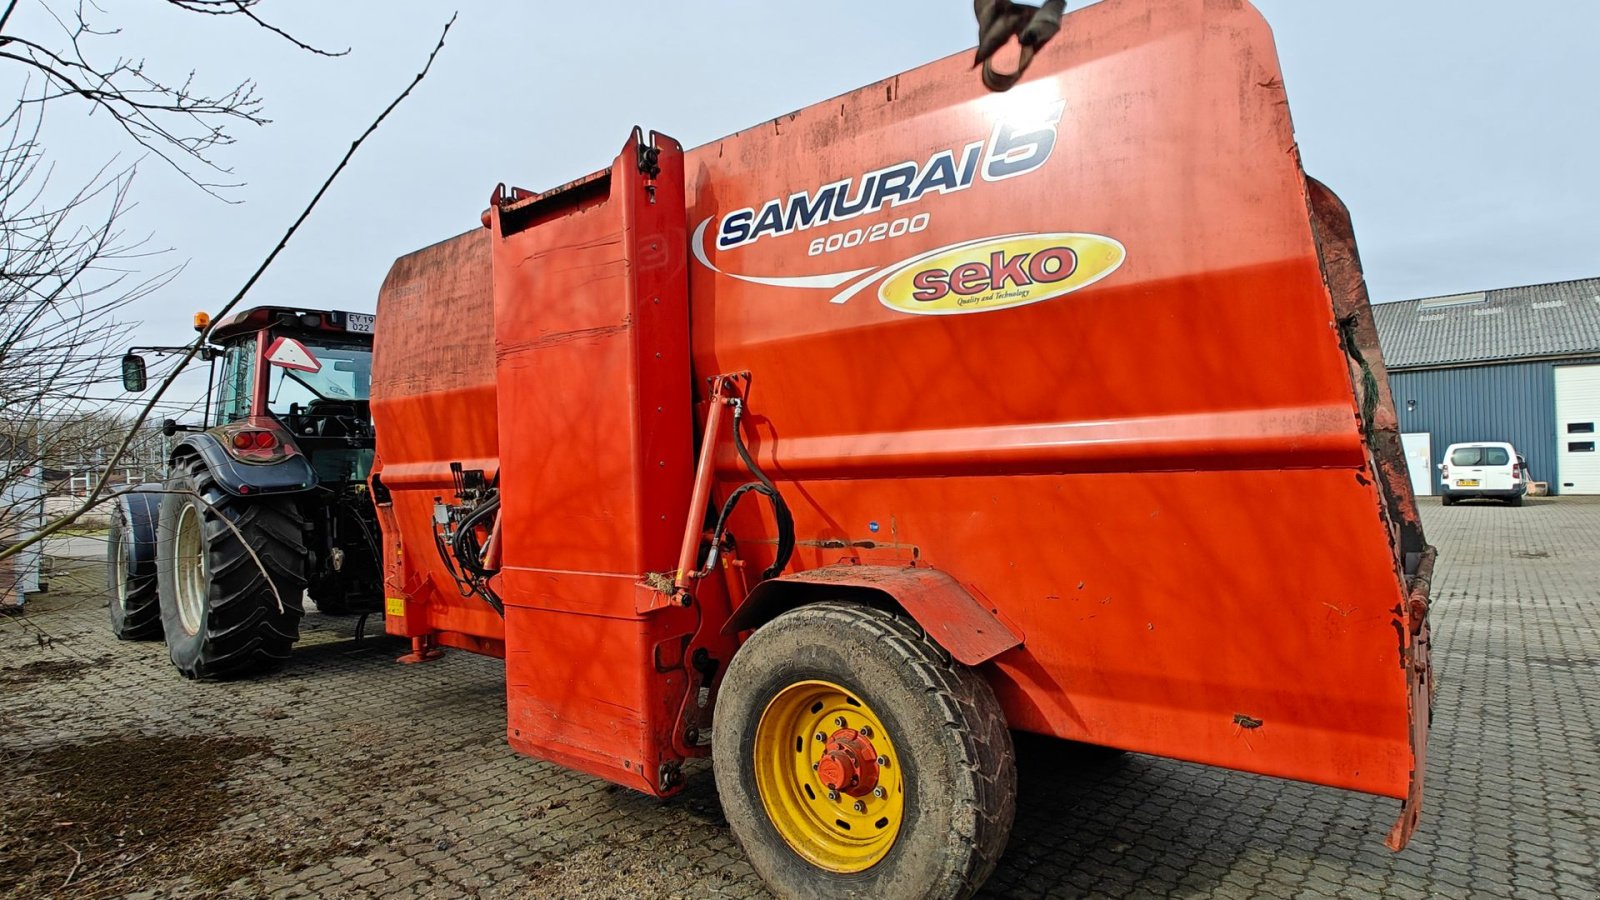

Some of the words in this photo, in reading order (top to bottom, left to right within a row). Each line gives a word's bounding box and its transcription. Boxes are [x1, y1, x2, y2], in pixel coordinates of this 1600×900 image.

[807, 213, 930, 256] 600/200
[913, 246, 1078, 302] seko
[957, 296, 979, 305] Quality
[981, 293, 993, 301] and
[996, 289, 1030, 299] Technology
[352, 323, 369, 331] 022
